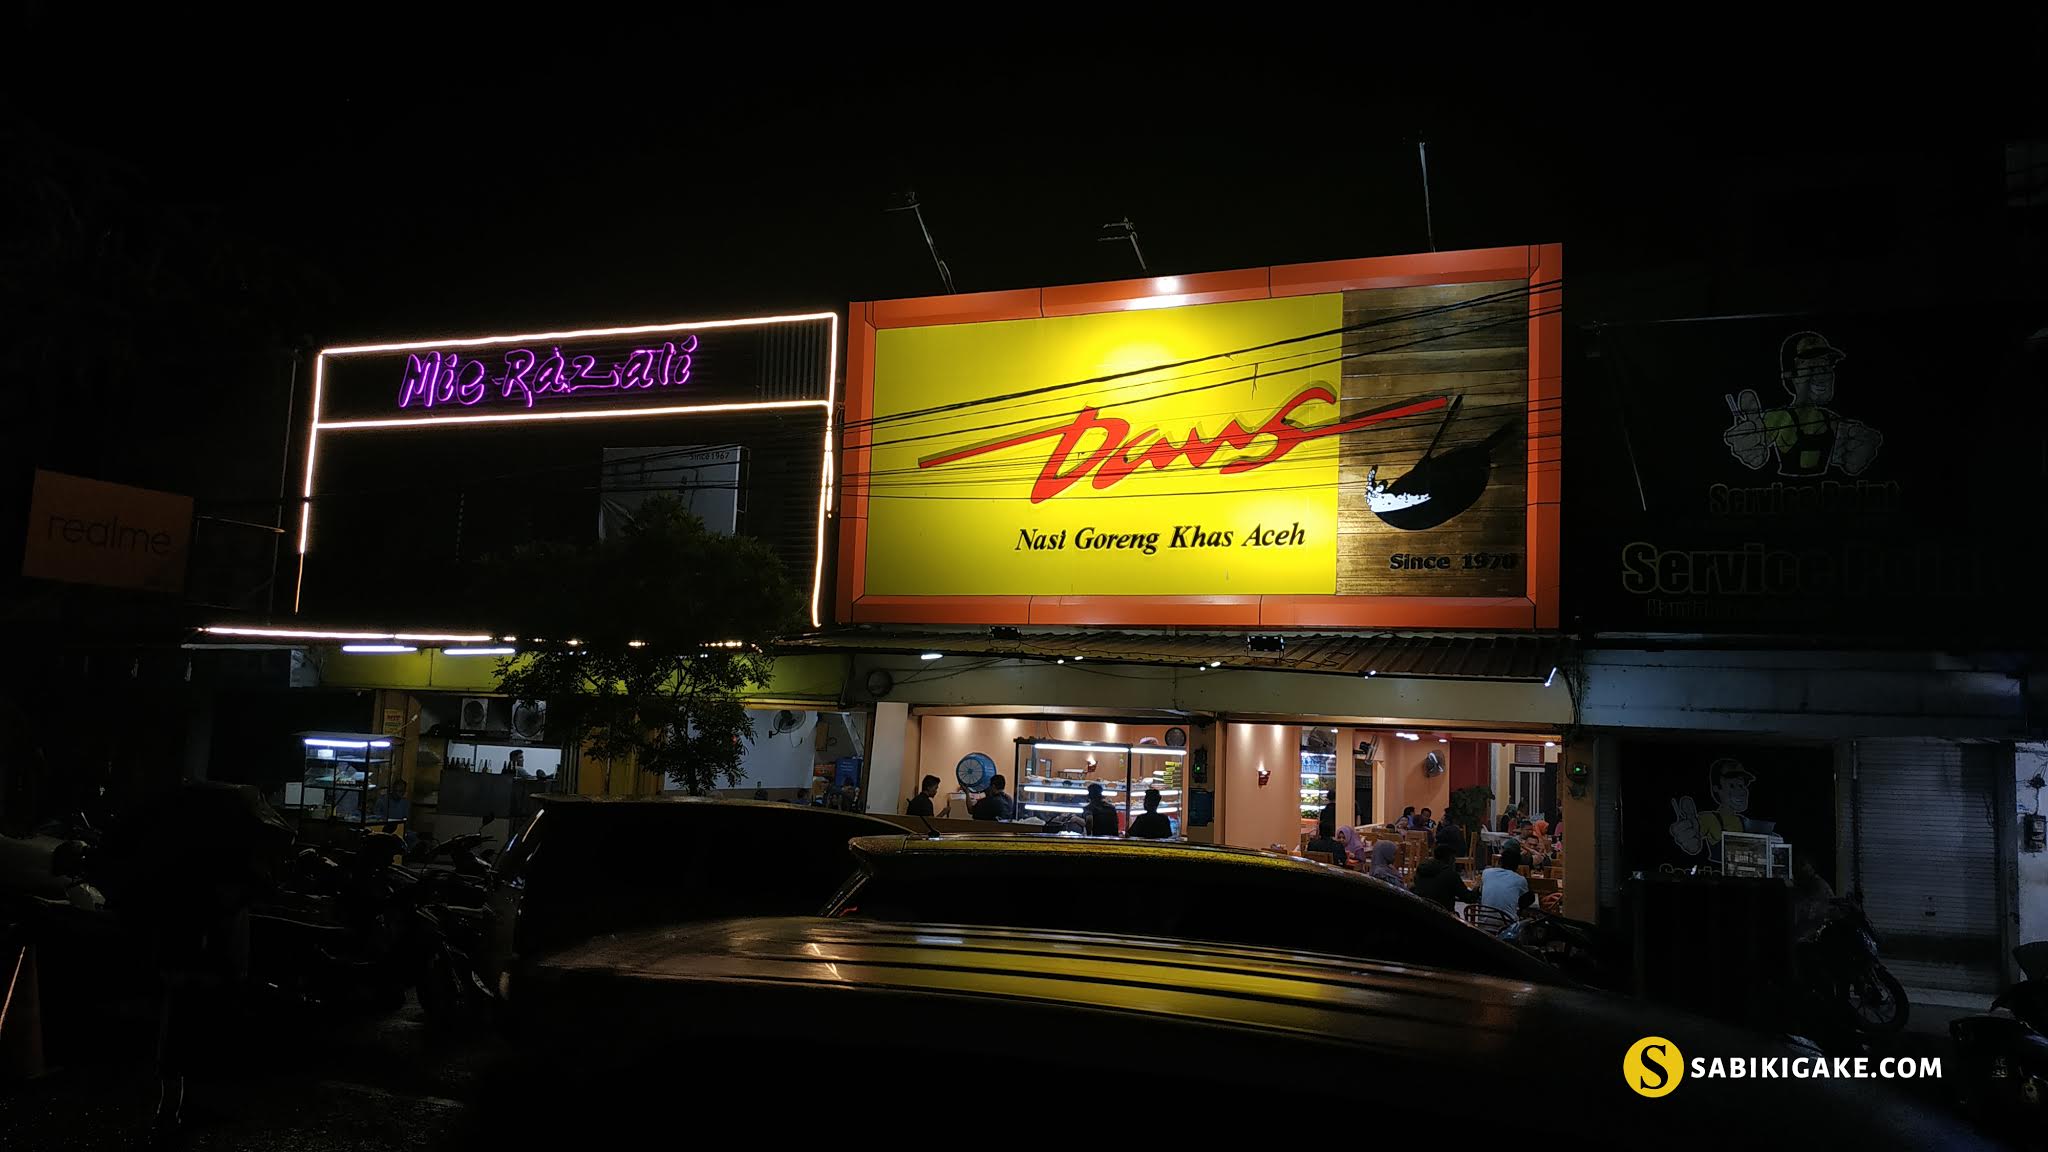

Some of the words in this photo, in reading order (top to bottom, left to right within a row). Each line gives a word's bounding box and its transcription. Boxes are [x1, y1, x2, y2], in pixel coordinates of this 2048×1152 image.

[397, 351, 485, 408] Mie
[49, 512, 172, 554] realme
[1015, 528, 1067, 551] Nasi
[1075, 527, 1160, 555] Goreng
[1167, 525, 1234, 549] Khas
[1241, 522, 1306, 547] Aceh
[1390, 553, 1451, 570] Since
[1621, 541, 1836, 596] Service
